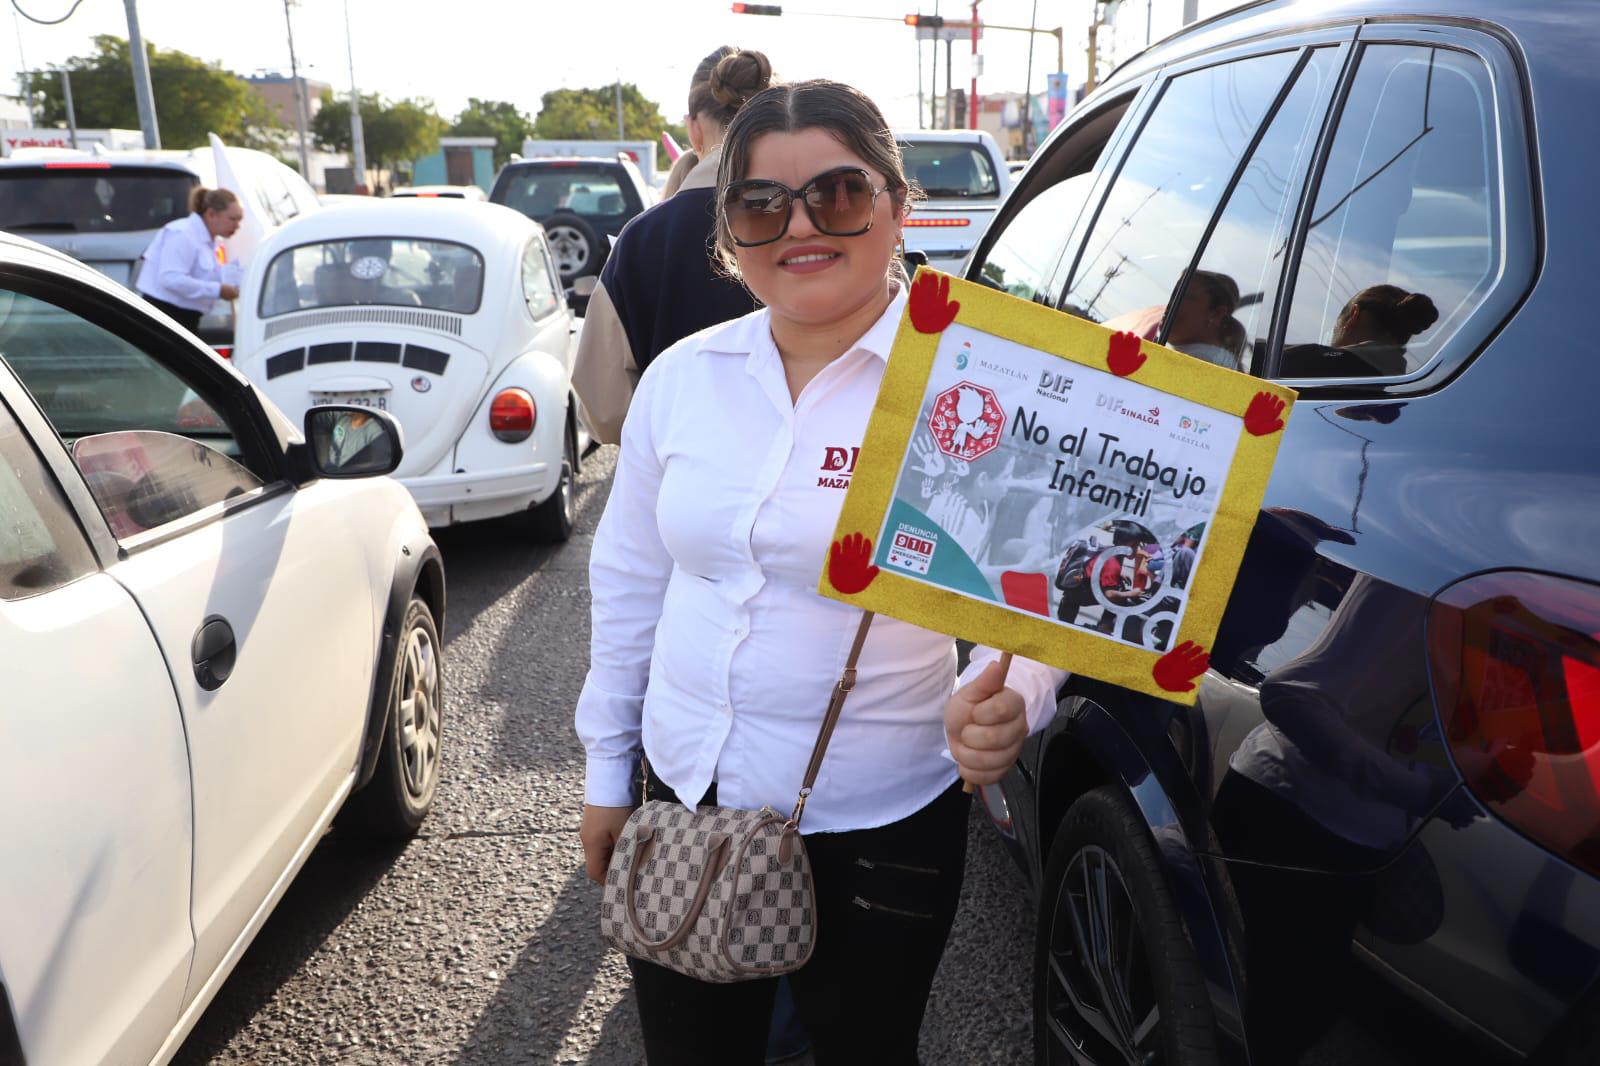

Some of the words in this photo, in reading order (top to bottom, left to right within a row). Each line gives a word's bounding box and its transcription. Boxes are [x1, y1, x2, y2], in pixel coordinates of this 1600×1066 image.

[1039, 368, 1074, 394] DIF
[1036, 388, 1069, 404] Nacional
[1120, 408, 1160, 426] SINALOA
[1011, 406, 1049, 445] No
[1059, 427, 1088, 457] al
[1099, 433, 1206, 499] Trabajo
[1048, 459, 1152, 517] Infantil
[898, 522, 938, 540] DENUNCIA
[897, 535, 931, 555] 911
